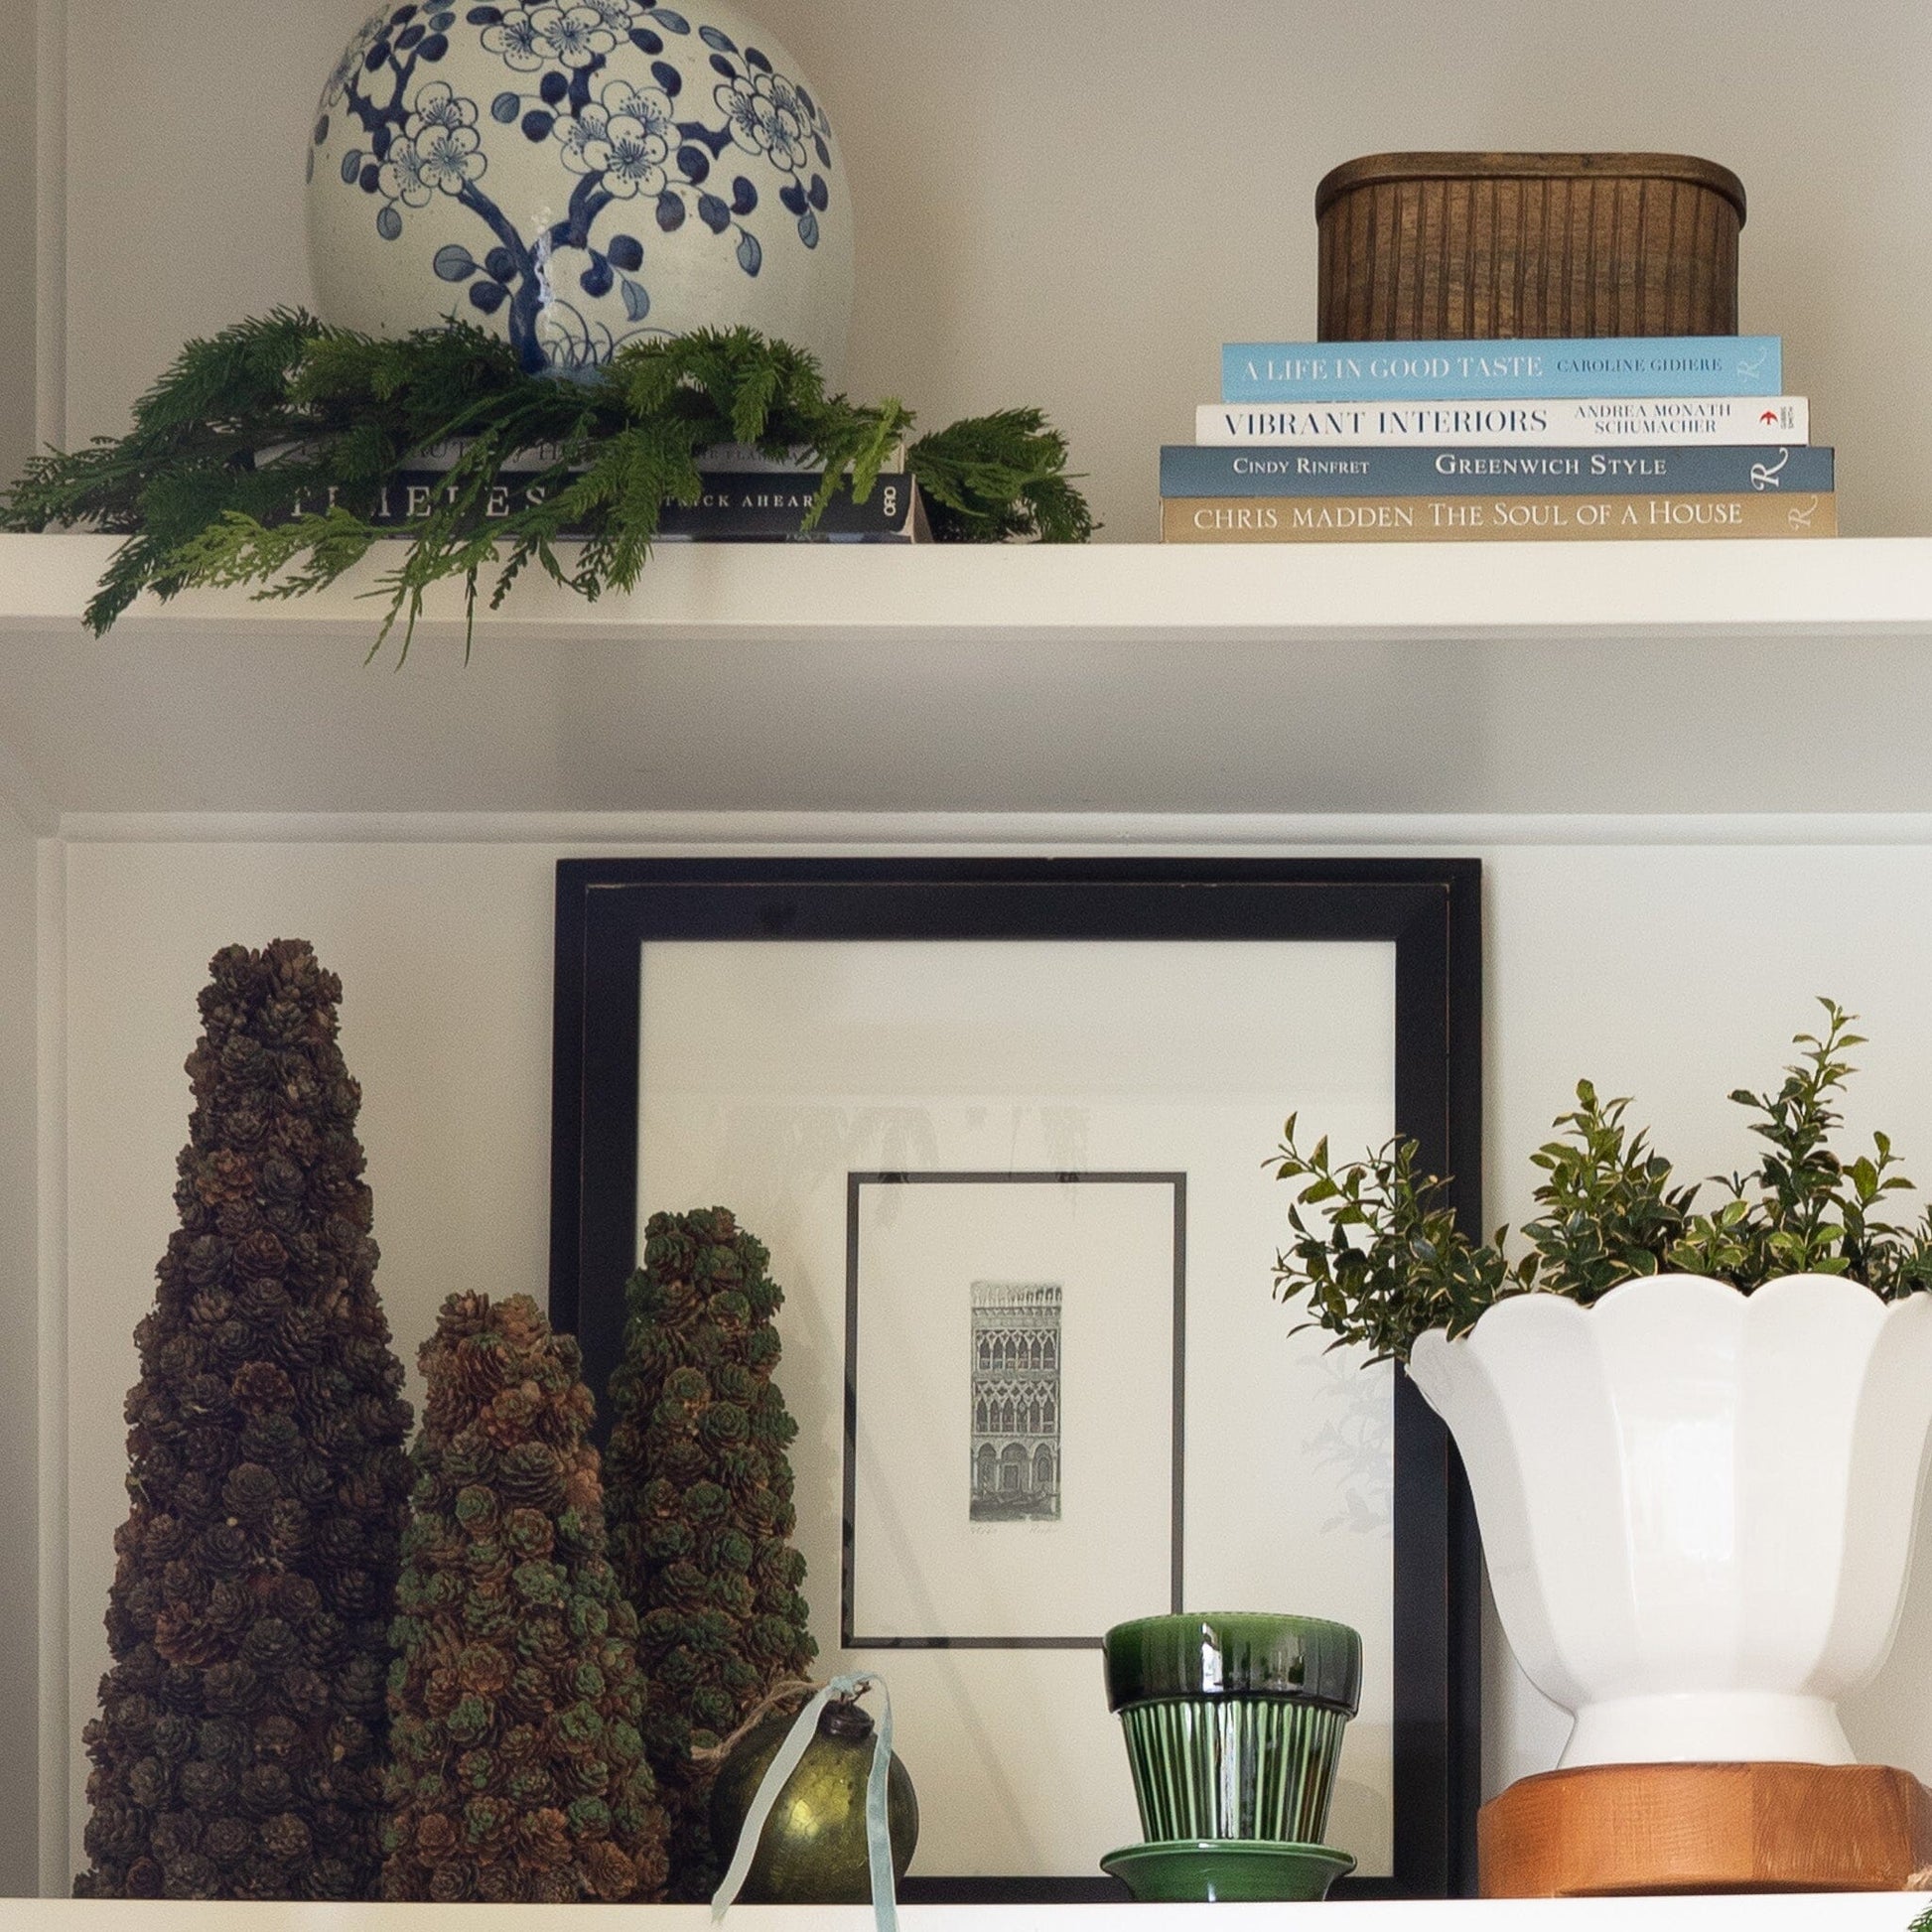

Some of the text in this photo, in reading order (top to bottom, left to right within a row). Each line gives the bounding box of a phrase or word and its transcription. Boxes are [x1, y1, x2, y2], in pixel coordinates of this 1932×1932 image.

[1243, 355, 1543, 381] A LIFE IN GOOD TASTE
[1557, 358, 1646, 374] CAROLINE
[1575, 403, 1731, 419] ANDREA MONATH
[1225, 409, 1548, 436] VIBRANT INTERIORS
[1594, 419, 1718, 435] SCHUMACHER
[1233, 457, 1370, 476] CINDY RINFRET
[1435, 454, 1667, 476] GREENWICH STYLE
[742, 494, 814, 508] AHEAR
[1193, 500, 1743, 529] CHRIS MADDEN THE SOUL OF A HOUSE
